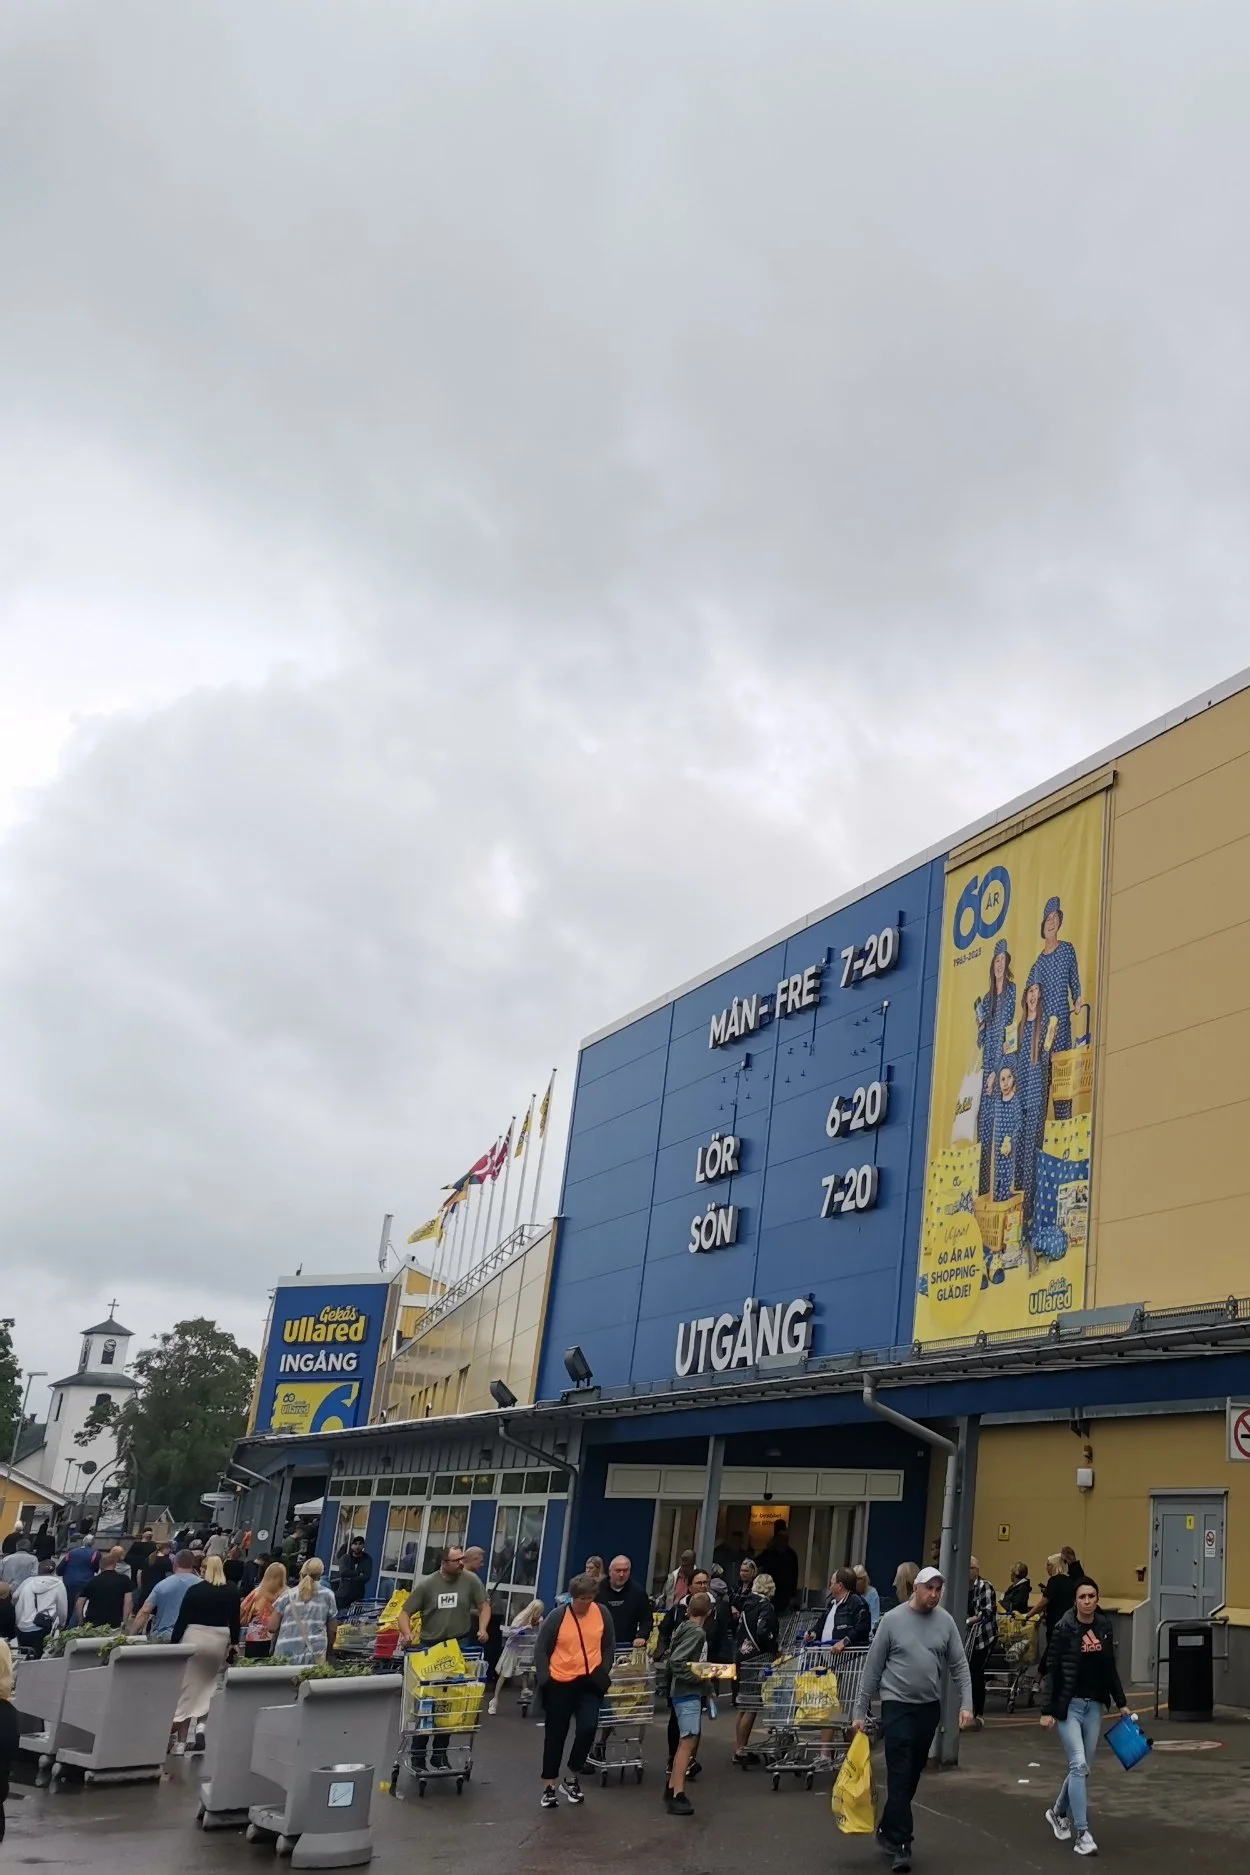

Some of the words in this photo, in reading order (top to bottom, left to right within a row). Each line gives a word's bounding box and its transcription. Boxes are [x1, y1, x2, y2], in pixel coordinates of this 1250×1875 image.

[953, 866, 1011, 950] 60
[985, 891, 1000, 910] ÅR
[840, 928, 899, 988] 7-20
[695, 1132, 740, 1183] LÖR
[825, 1081, 888, 1138] 6-20
[688, 1202, 740, 1253] SÖN
[820, 1165, 881, 1218] 7-20
[938, 1251, 948, 1265] 60
[950, 1247, 963, 1263] ÅR
[964, 1245, 976, 1260] AV
[930, 1264, 980, 1285] SHOPPING-
[937, 1283, 972, 1301] GLÄDJE!
[1029, 1283, 1072, 1314] Ullared
[320, 1305, 358, 1322] Gekås
[283, 1315, 366, 1343] Ullared
[675, 1298, 813, 1376] UTGÅNG
[280, 1350, 358, 1372] INGÅNG
[440, 1596, 455, 1605] HH
